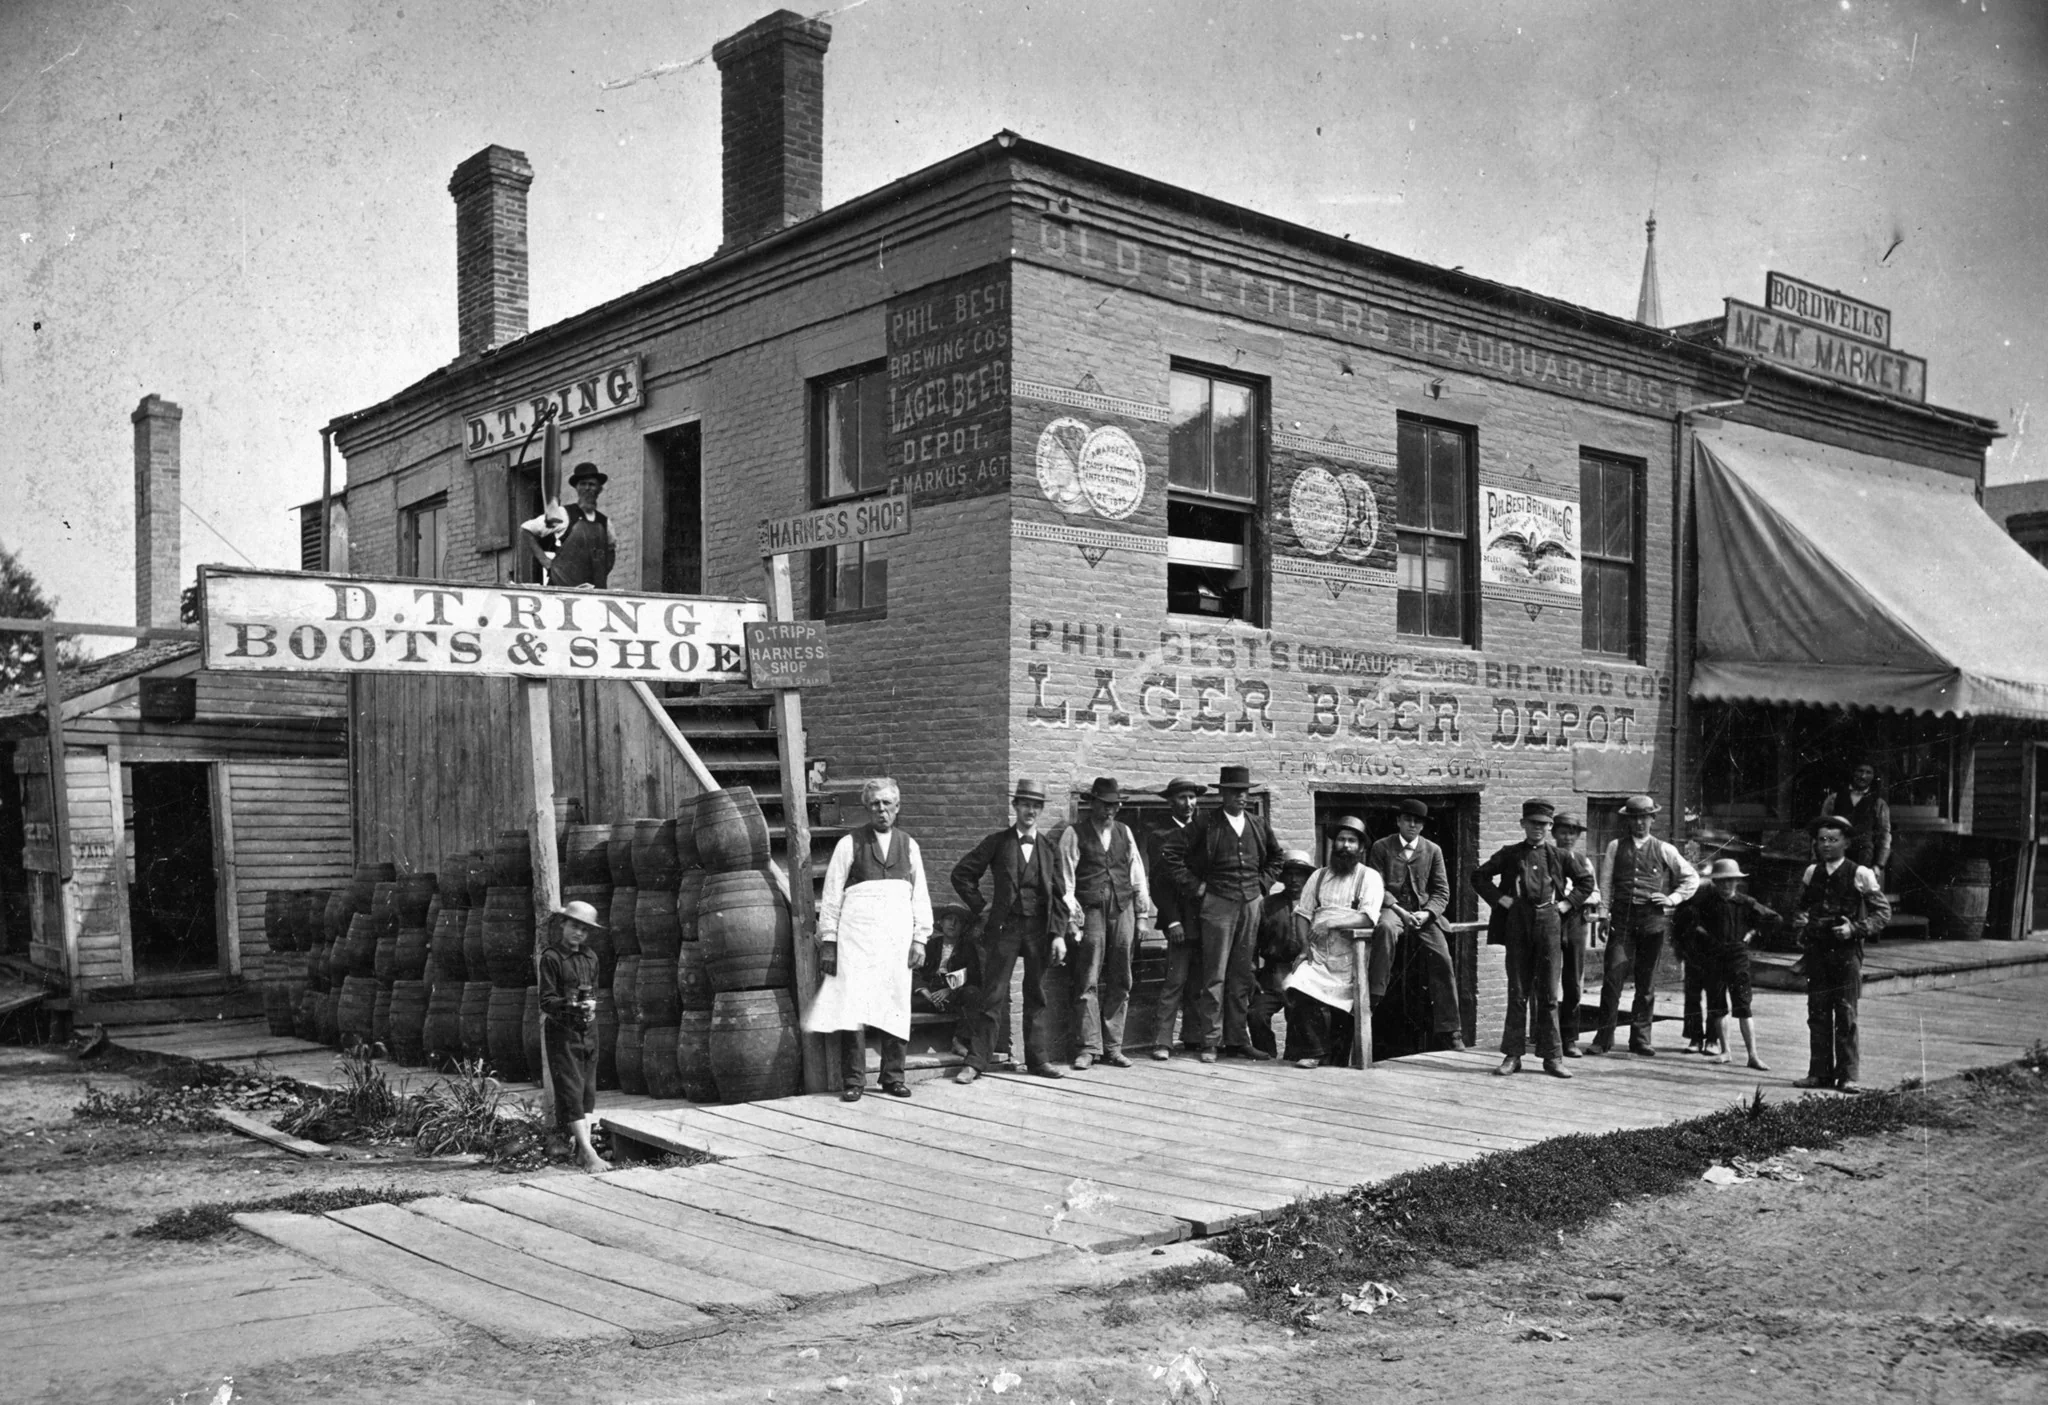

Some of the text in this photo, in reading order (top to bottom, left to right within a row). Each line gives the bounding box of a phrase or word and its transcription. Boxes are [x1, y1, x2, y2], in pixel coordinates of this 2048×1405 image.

[1040, 219, 1141, 276] OLD
[1167, 254, 1389, 341] SETTLERS
[892, 281, 1008, 342] PHIL. BEST
[1772, 278, 1884, 339] BORDWELL'S
[890, 337, 966, 379] BREWING
[1735, 310, 1914, 395] MEAT MARKET.
[889, 360, 1008, 434] LAGER BEER
[903, 424, 989, 465] DEPOT.
[769, 501, 904, 550] HARNESS SHOP
[1506, 493, 1525, 514] BEST
[1526, 495, 1562, 528] BREWING
[501, 594, 702, 638] RING
[225, 622, 483, 664] BOOTS
[507, 632, 548, 666] &
[751, 646, 825, 661] HARNESS
[1030, 618, 1146, 660] PHIL.
[1485, 661, 1613, 696] BREWING
[1624, 669, 1671, 700] CO'S
[771, 661, 808, 674] SHOP
[1026, 662, 1648, 754] LAGER BEER DEPOT.
[1428, 757, 1508, 779] AGENT.
